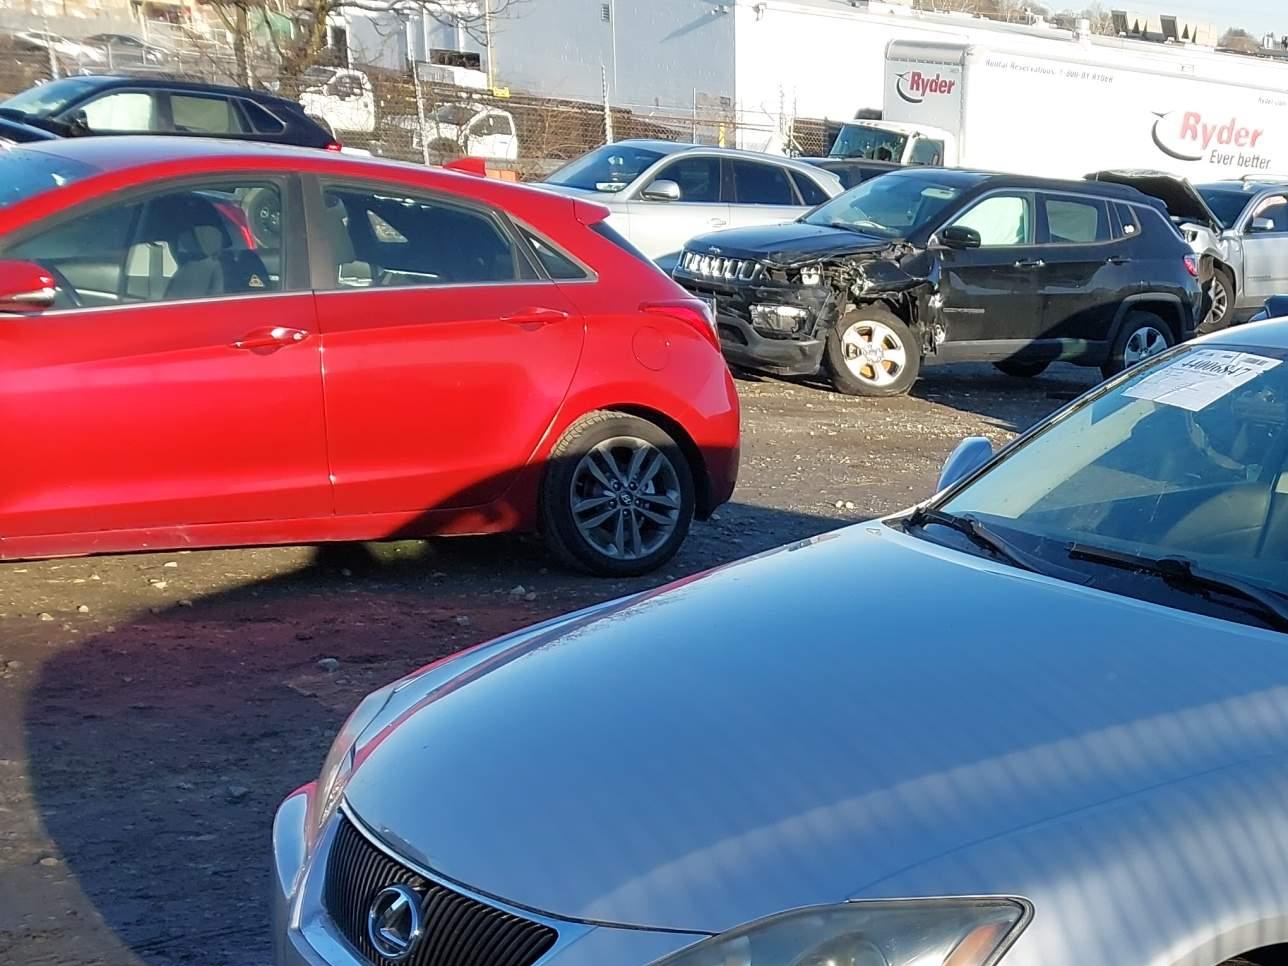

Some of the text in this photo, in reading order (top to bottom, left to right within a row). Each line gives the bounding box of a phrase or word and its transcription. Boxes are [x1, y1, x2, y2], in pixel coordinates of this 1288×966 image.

[909, 71, 956, 97] Ryder
[1180, 111, 1264, 151] Ryder
[1209, 149, 1235, 165] Ever
[1182, 358, 1252, 378] 44006847
